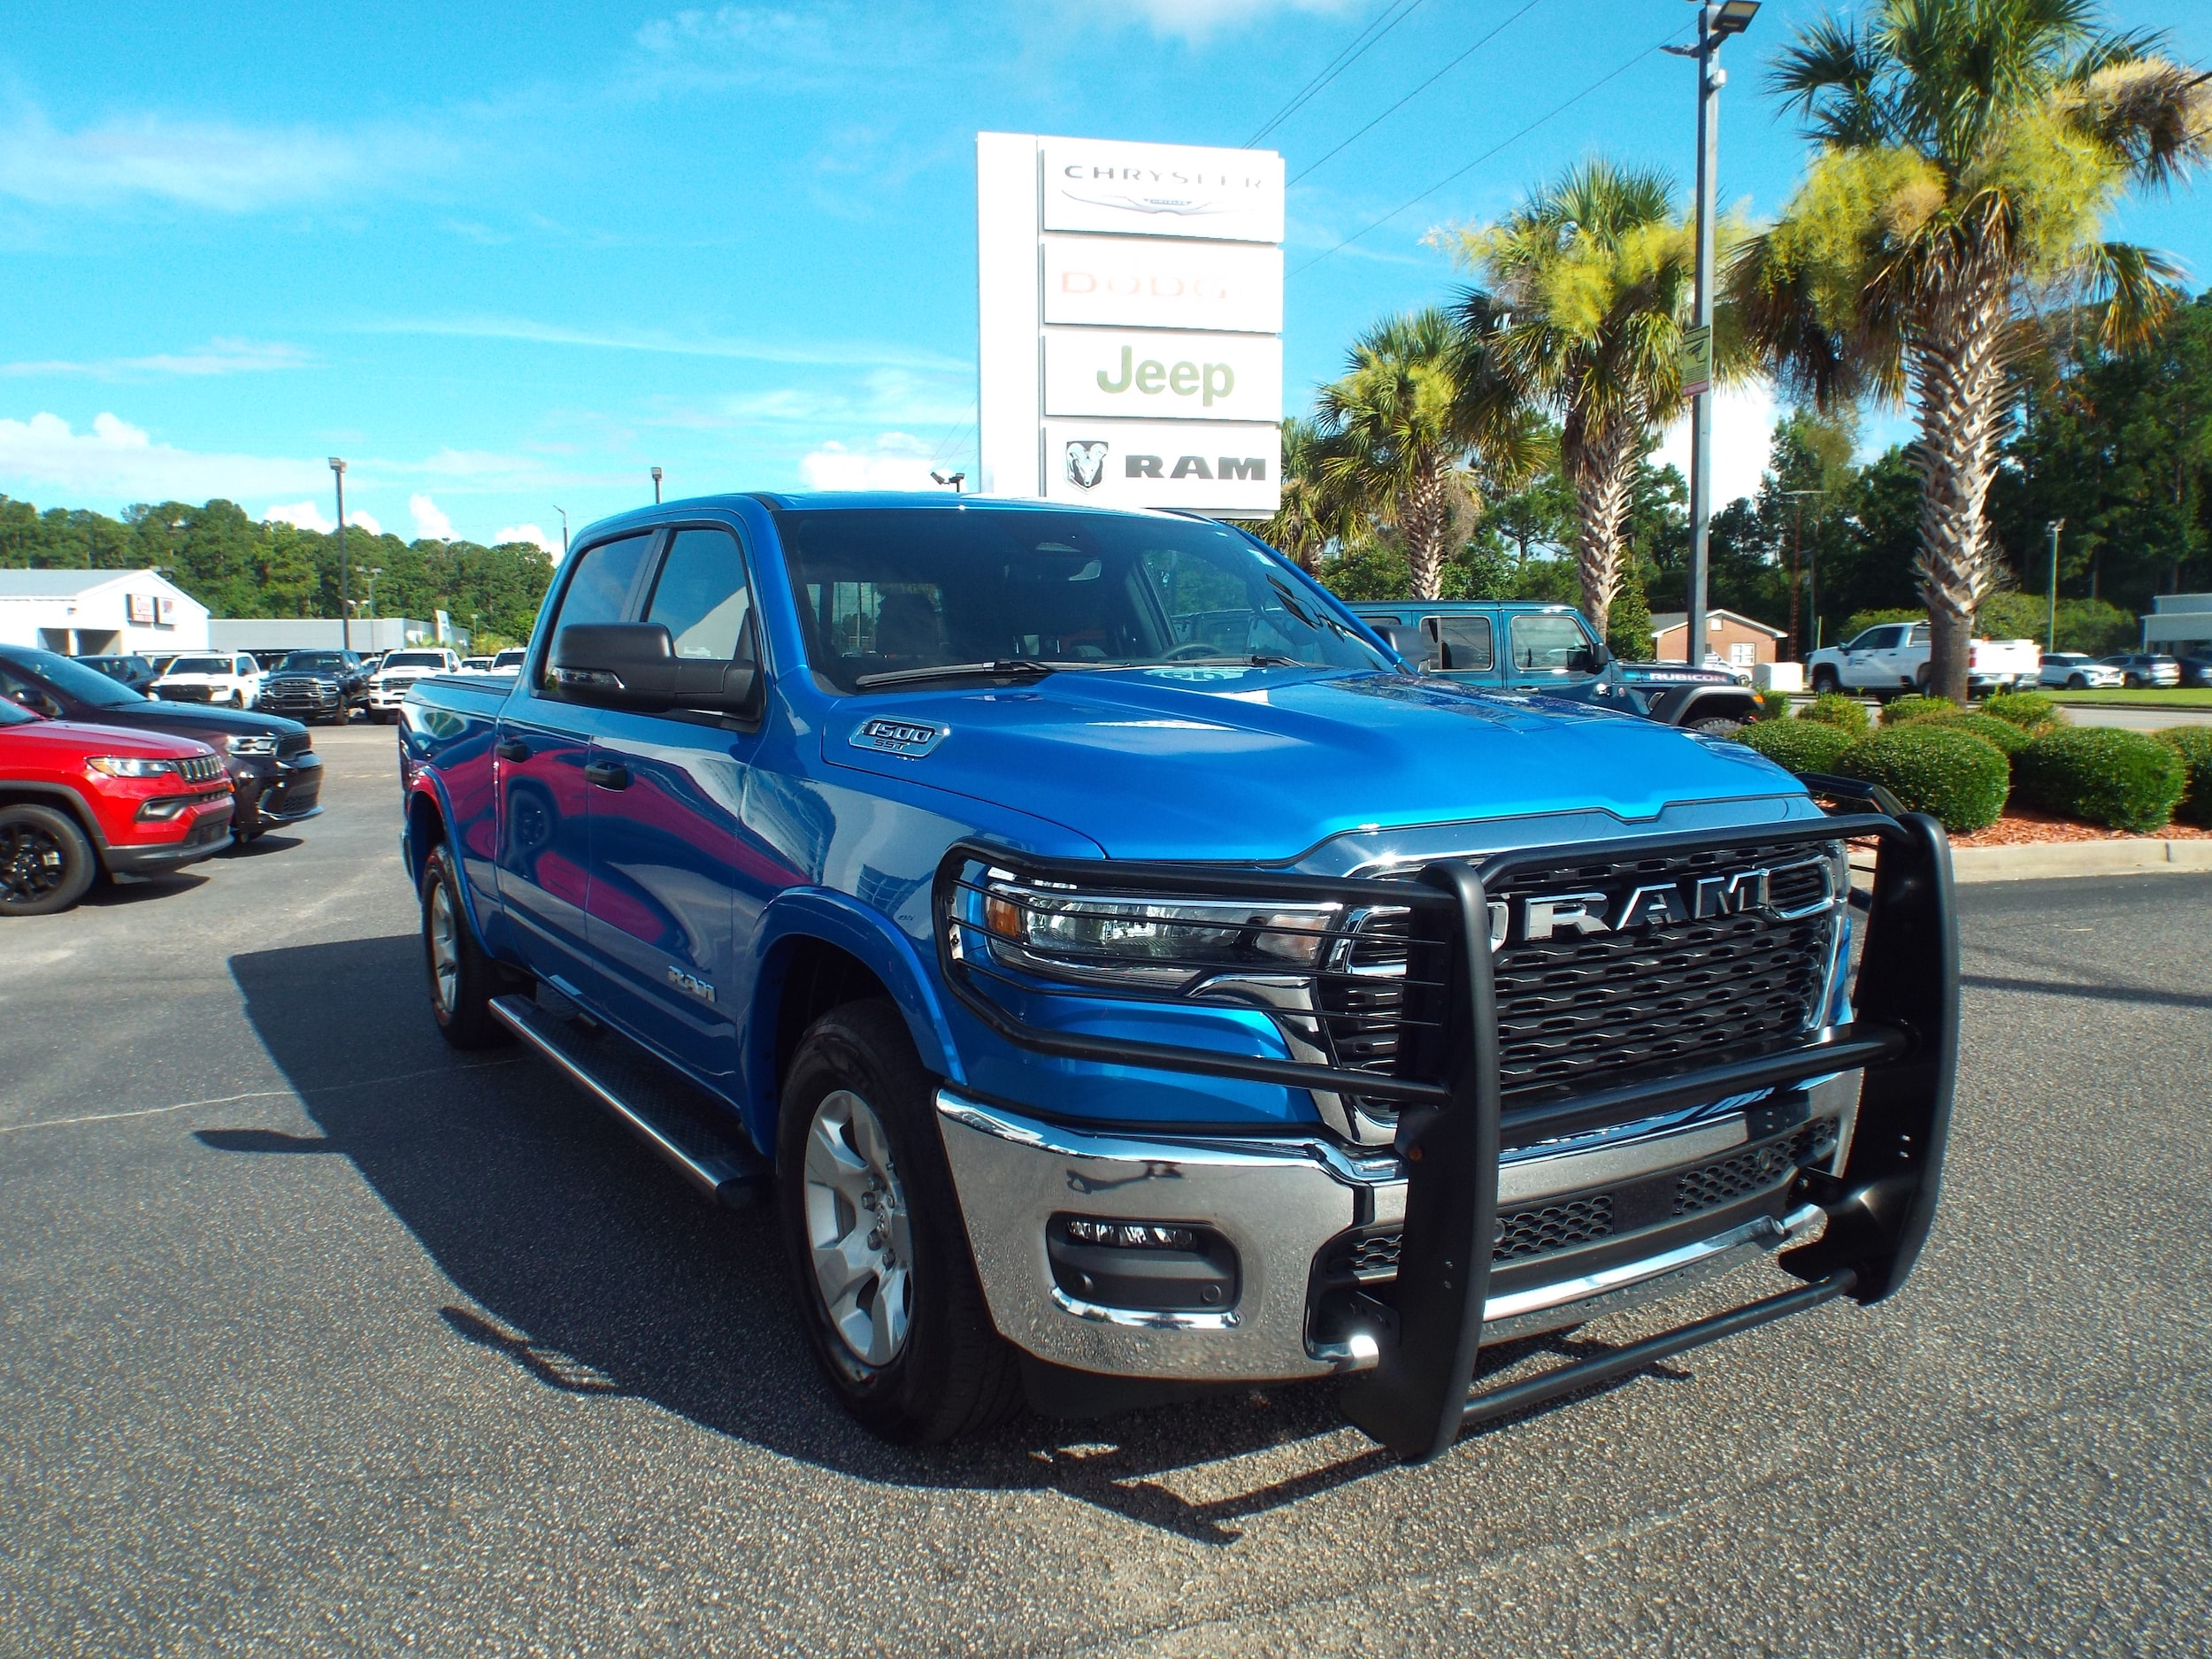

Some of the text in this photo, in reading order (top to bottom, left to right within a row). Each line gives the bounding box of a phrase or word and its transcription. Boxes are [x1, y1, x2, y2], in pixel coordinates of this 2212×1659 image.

[1062, 271, 1243, 299] DODG
[1096, 345, 1235, 407] Jeep
[1125, 454, 1266, 481] RAM
[1649, 672, 1728, 682] RUBICON
[868, 722, 933, 743] 1500
[872, 739, 910, 751] SST
[1524, 869, 1769, 941] RAM
[668, 964, 717, 1002] RAM
